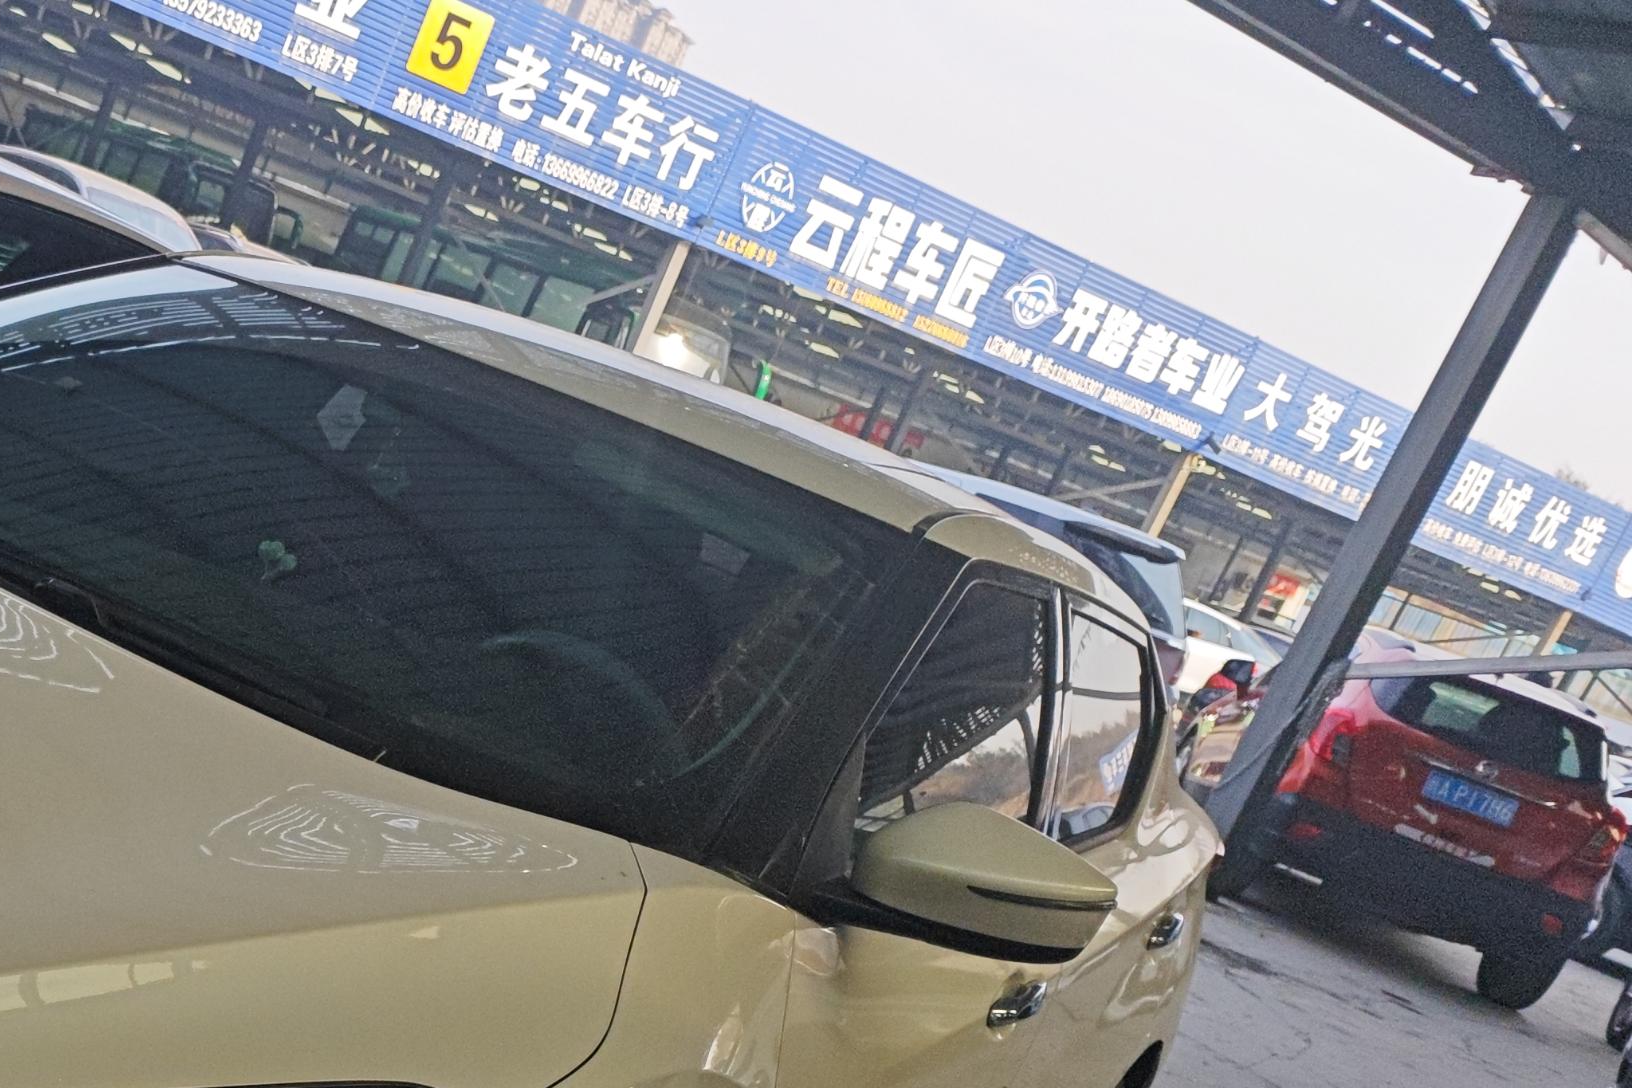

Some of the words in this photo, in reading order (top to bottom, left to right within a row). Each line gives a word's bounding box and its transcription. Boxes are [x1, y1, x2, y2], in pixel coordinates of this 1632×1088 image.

[281, 33, 358, 82] L区3排7号
[430, 11, 472, 71] 5
[570, 30, 625, 72] Talat
[627, 58, 681, 98] Kanji
[484, 41, 720, 191] 老五车行
[789, 174, 1006, 329] 云程车匠
[1052, 288, 1246, 415] 开路者车业
[1446, 460, 1608, 566] 朋诚优选
